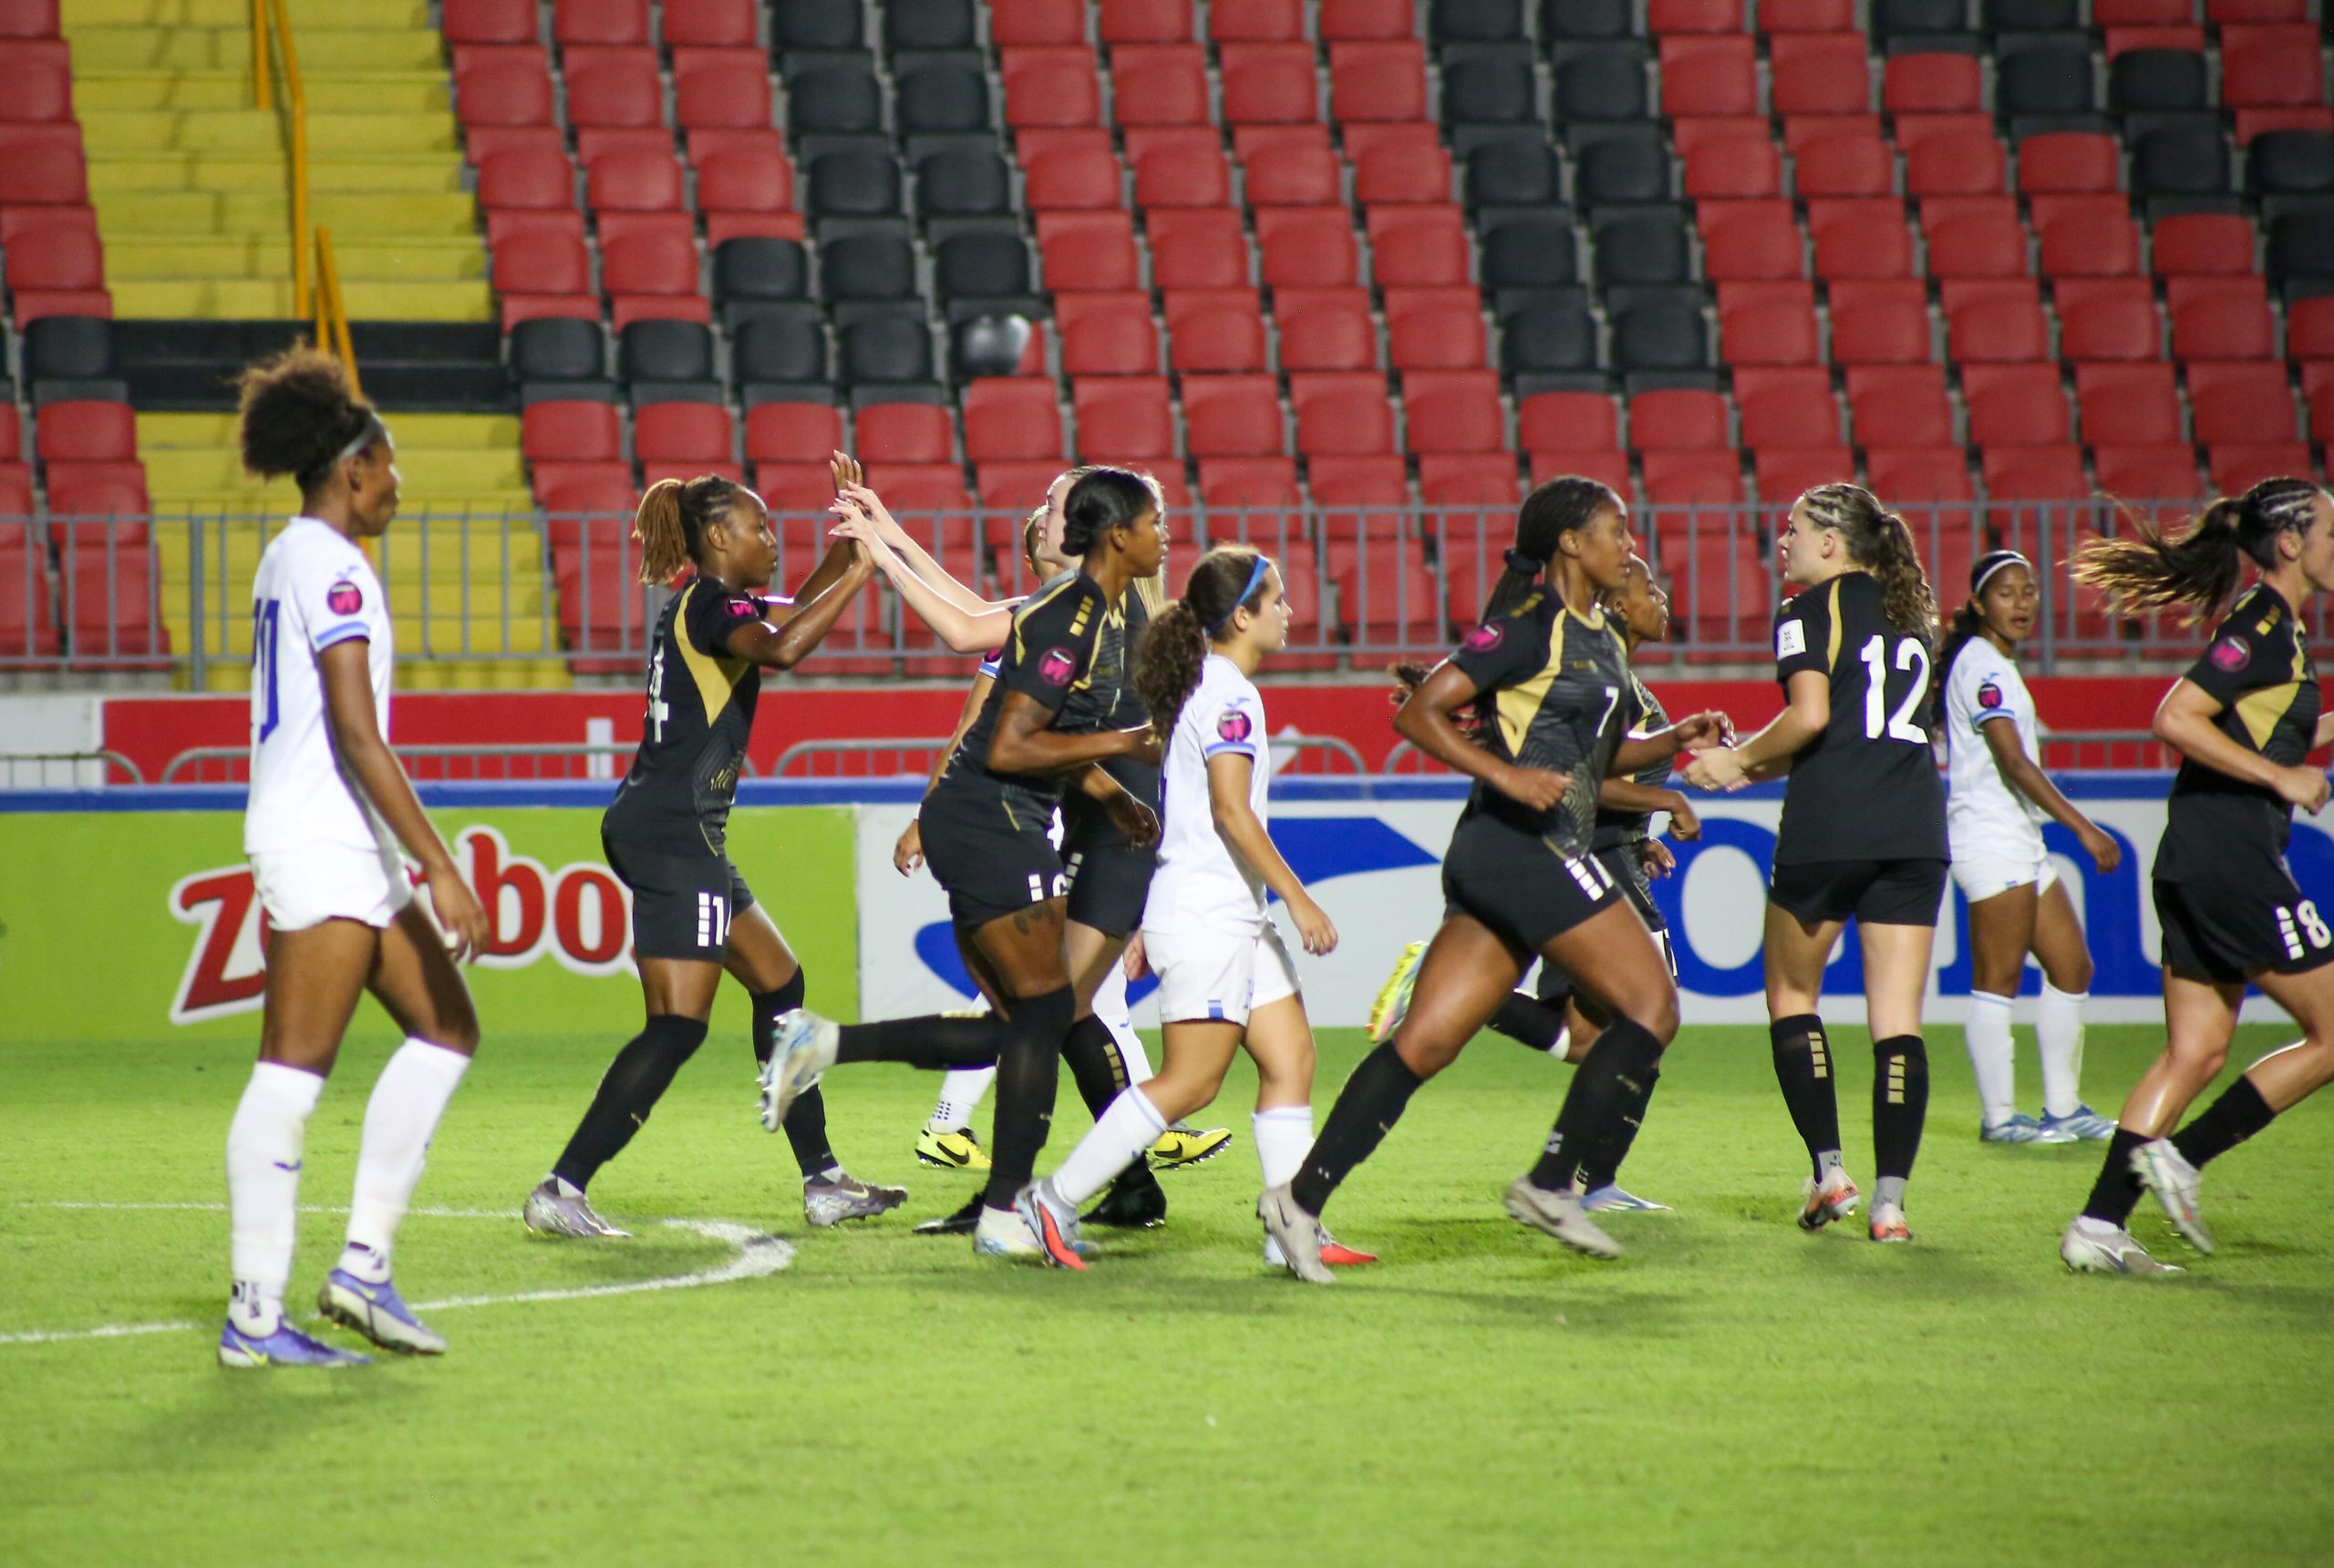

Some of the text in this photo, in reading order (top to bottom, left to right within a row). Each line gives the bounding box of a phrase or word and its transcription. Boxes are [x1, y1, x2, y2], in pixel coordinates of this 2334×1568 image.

[1596, 686, 1619, 738] 7
[1861, 634, 1930, 744] 12
[2297, 899, 2332, 949] 8
